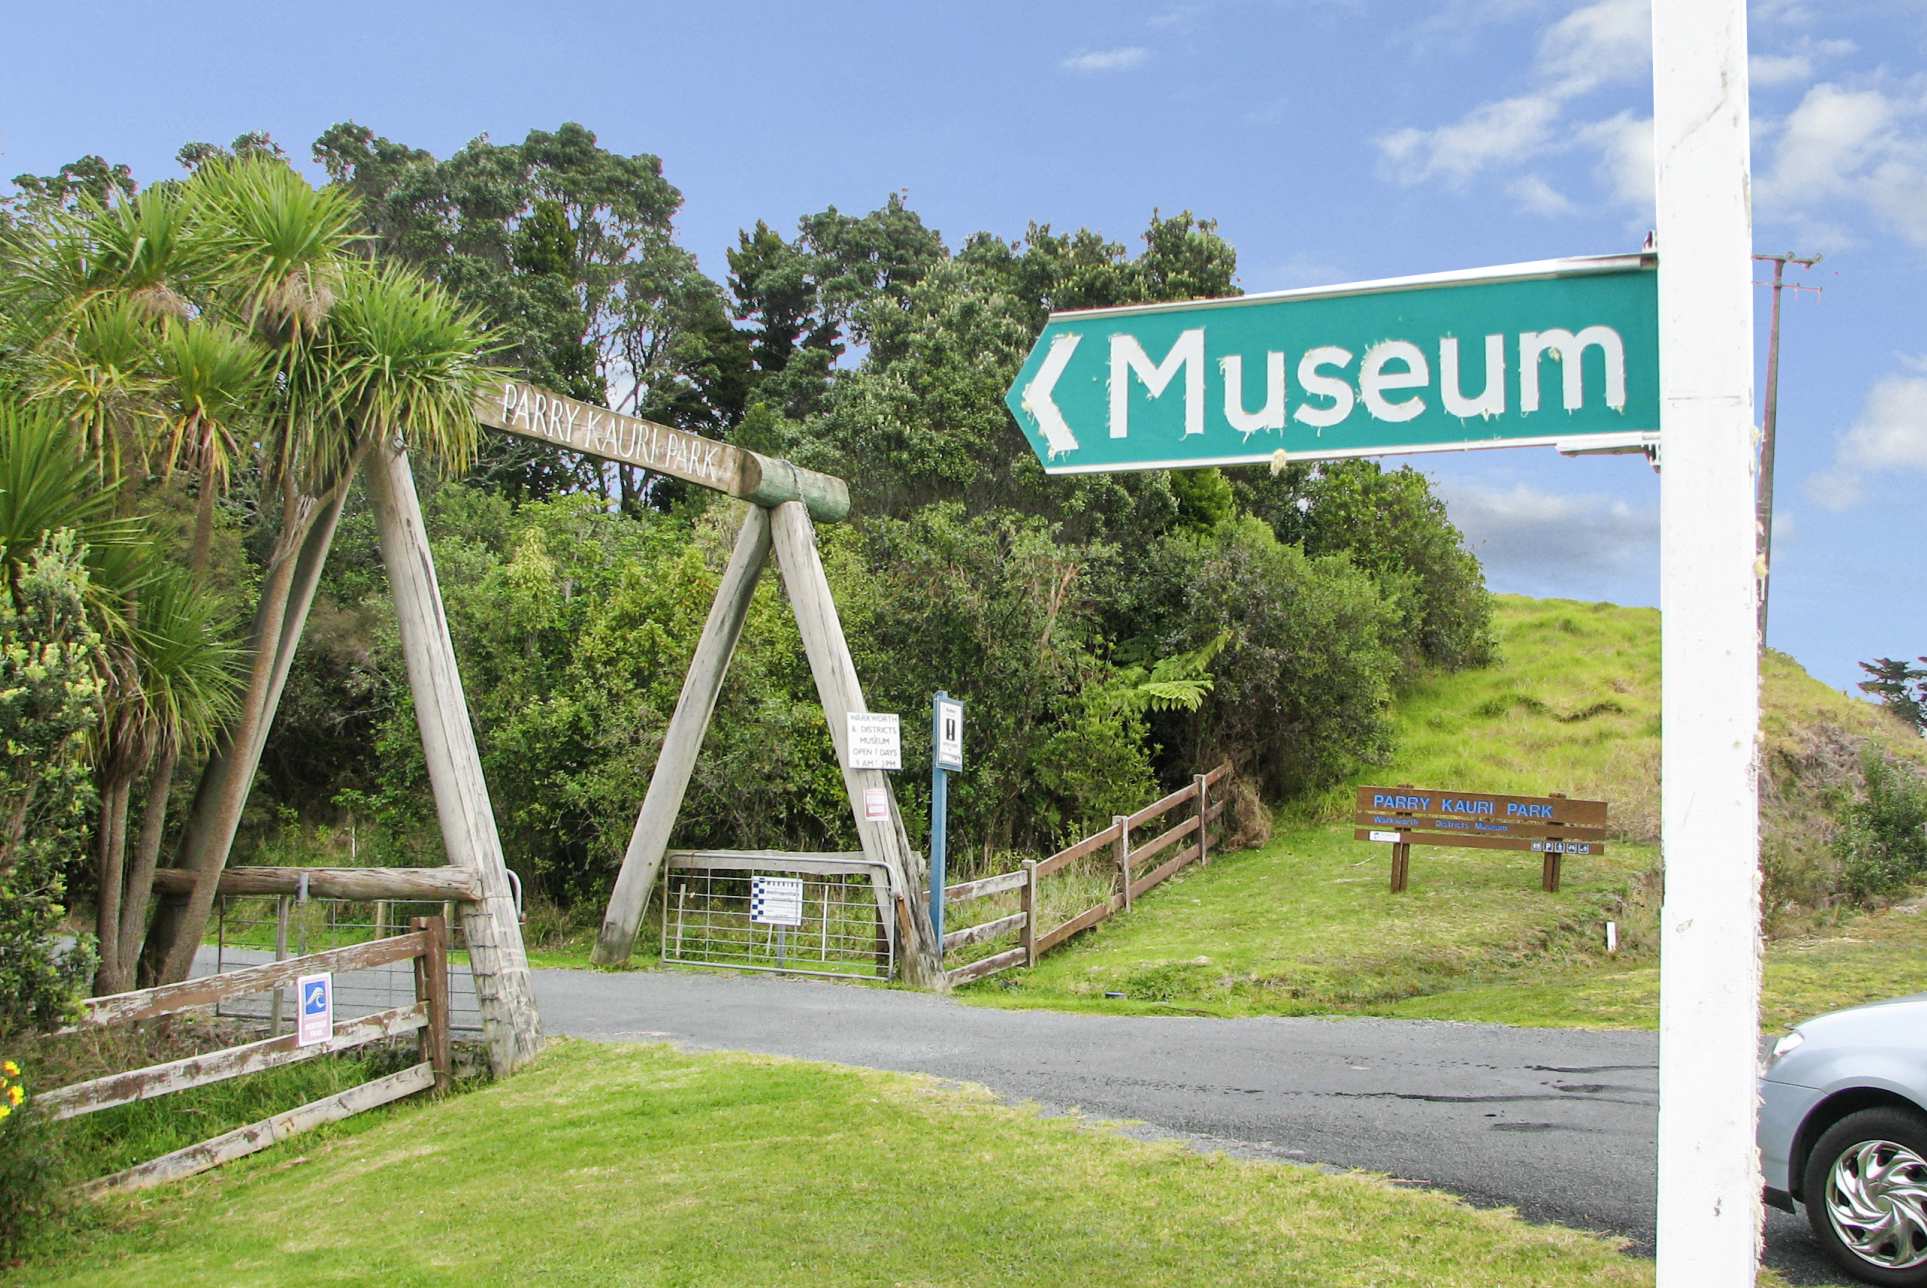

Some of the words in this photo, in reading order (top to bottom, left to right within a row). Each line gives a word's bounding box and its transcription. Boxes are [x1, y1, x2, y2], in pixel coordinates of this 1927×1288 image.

[1108, 325, 1626, 439] Museum
[502, 384, 580, 443] PARRY
[585, 411, 658, 464] KAURI
[664, 434, 718, 482] PARK
[860, 726, 897, 735] DISTRICTS
[859, 737, 890, 745] MUSEUM
[852, 748, 873, 756] OPEN
[880, 749, 898, 757] DAYS
[1373, 794, 1431, 811] PARRY
[1442, 799, 1495, 815] KAURI
[1507, 803, 1553, 818] PARK
